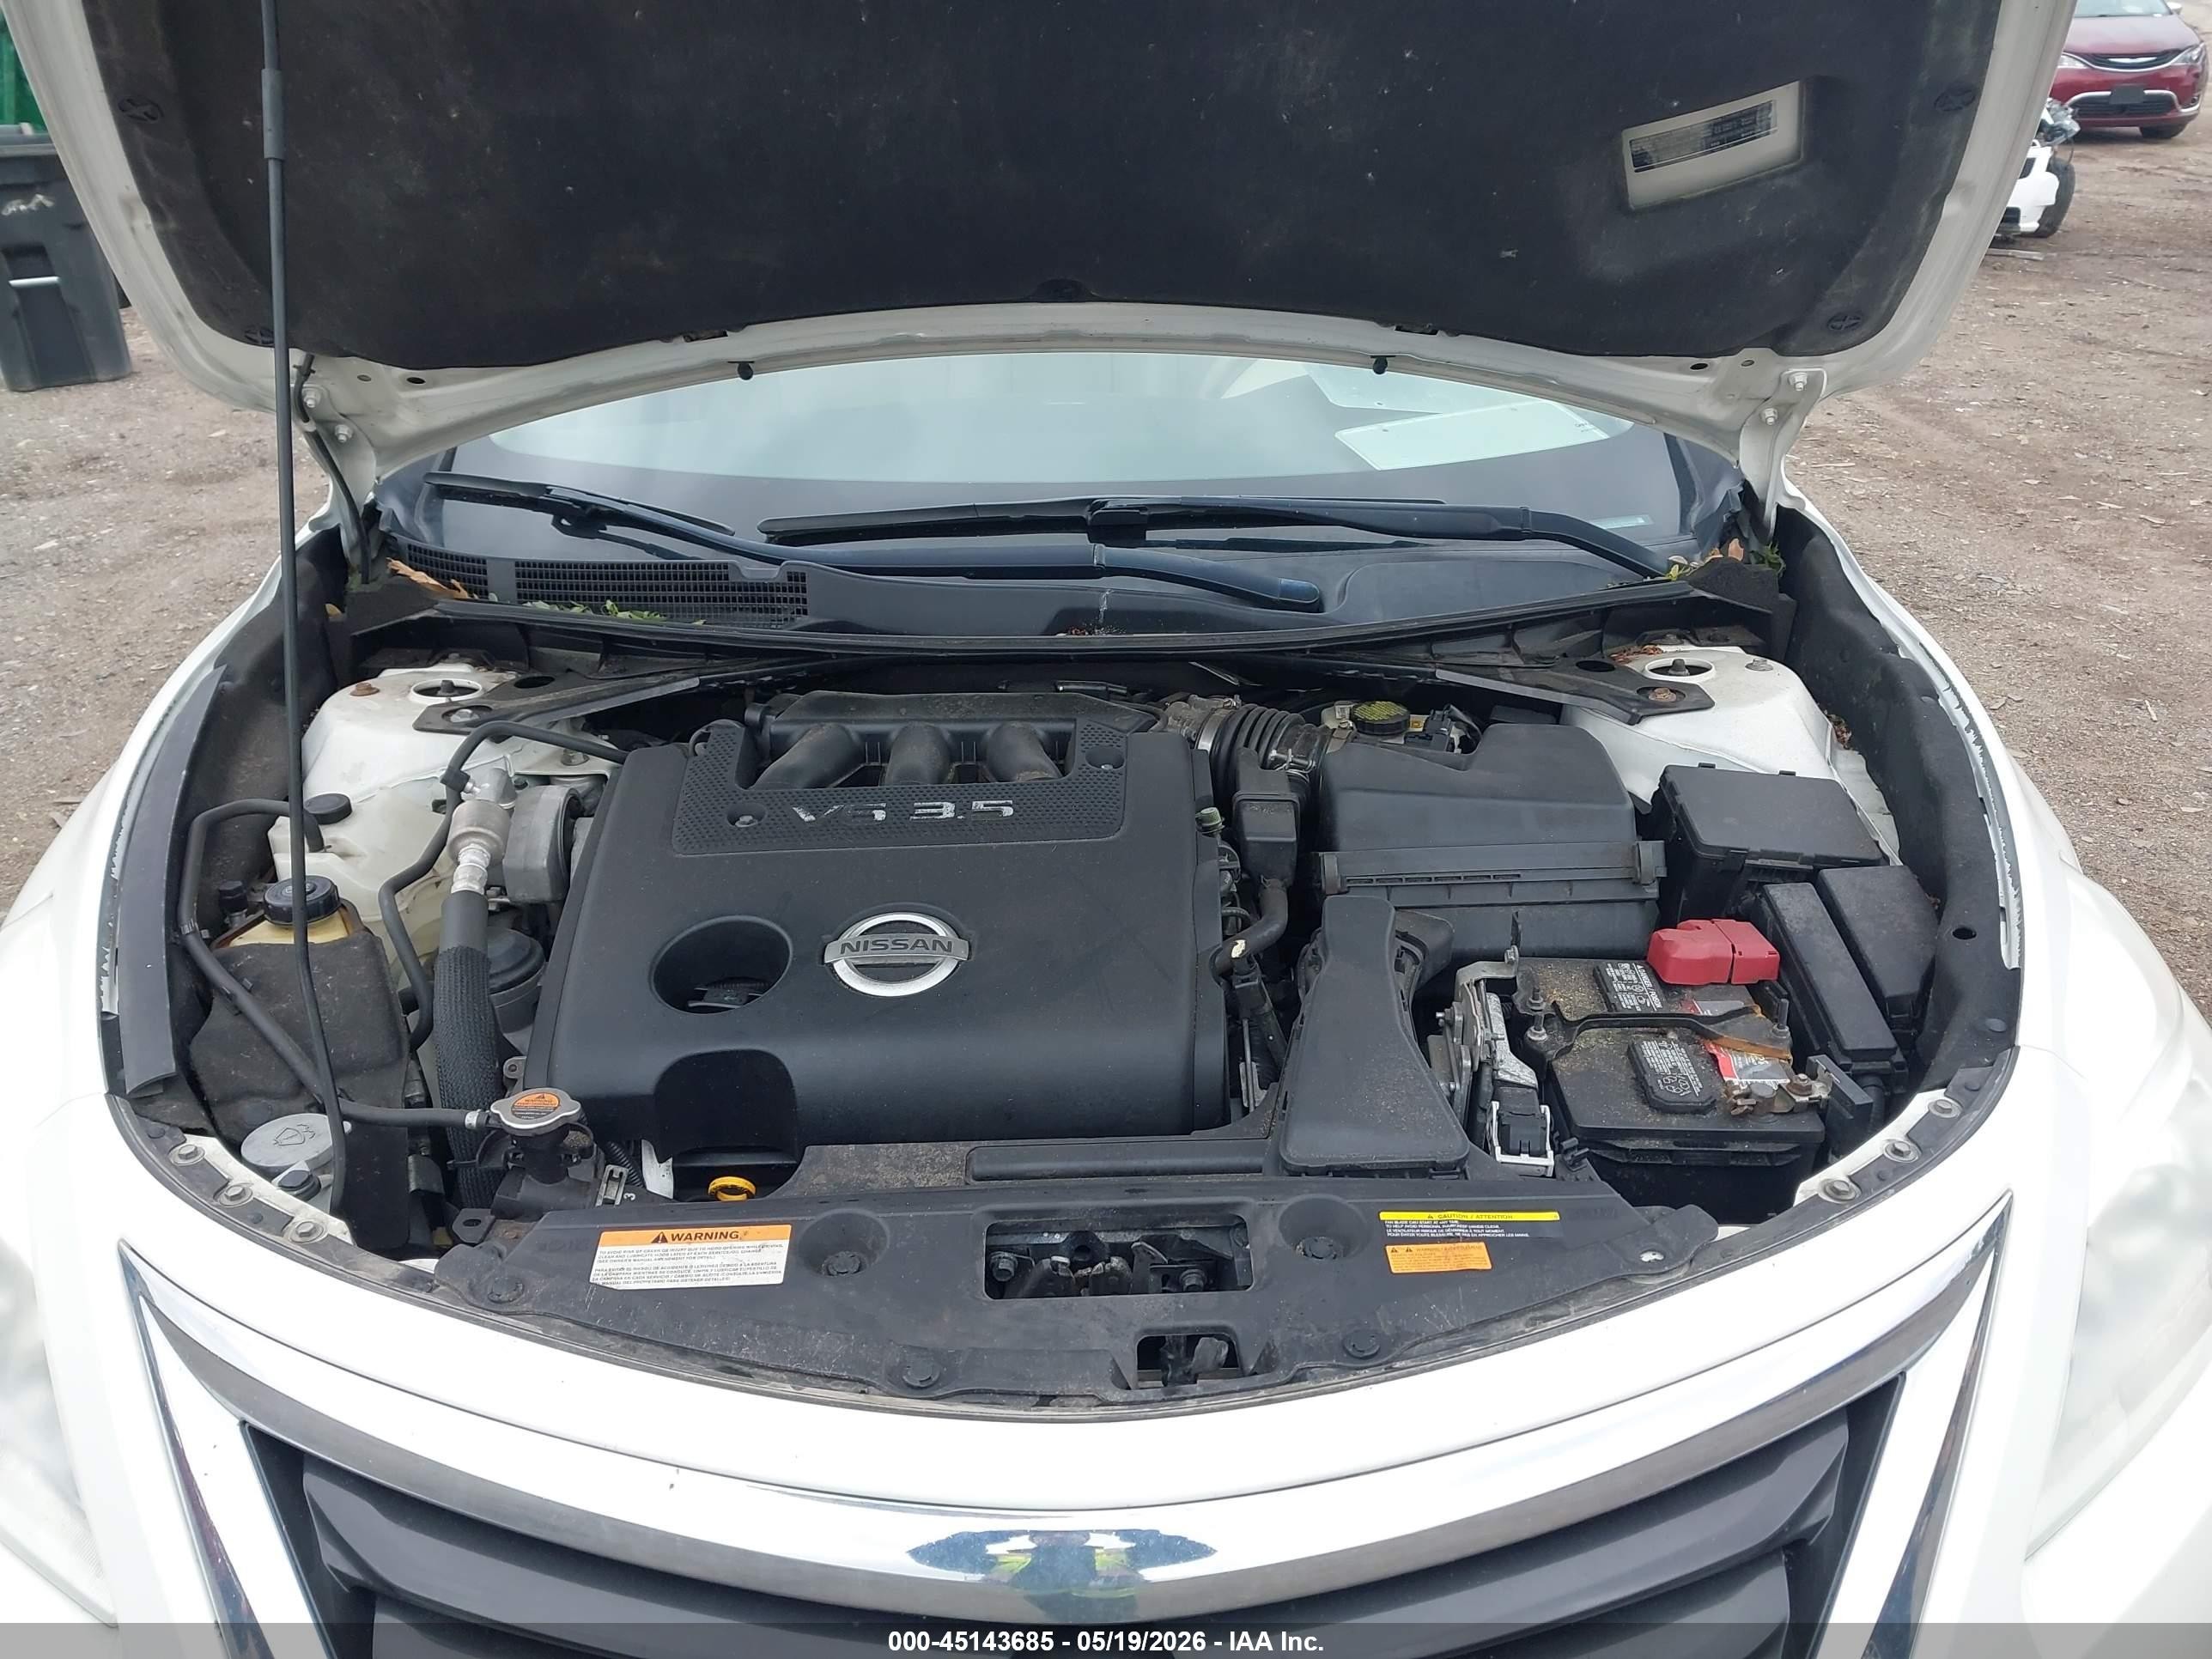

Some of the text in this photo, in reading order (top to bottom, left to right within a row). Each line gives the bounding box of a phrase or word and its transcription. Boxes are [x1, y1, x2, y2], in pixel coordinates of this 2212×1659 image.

[909, 799, 1015, 822] 3.5
[840, 939, 953, 953] NISSAN
[671, 1231, 739, 1242] WARNING
